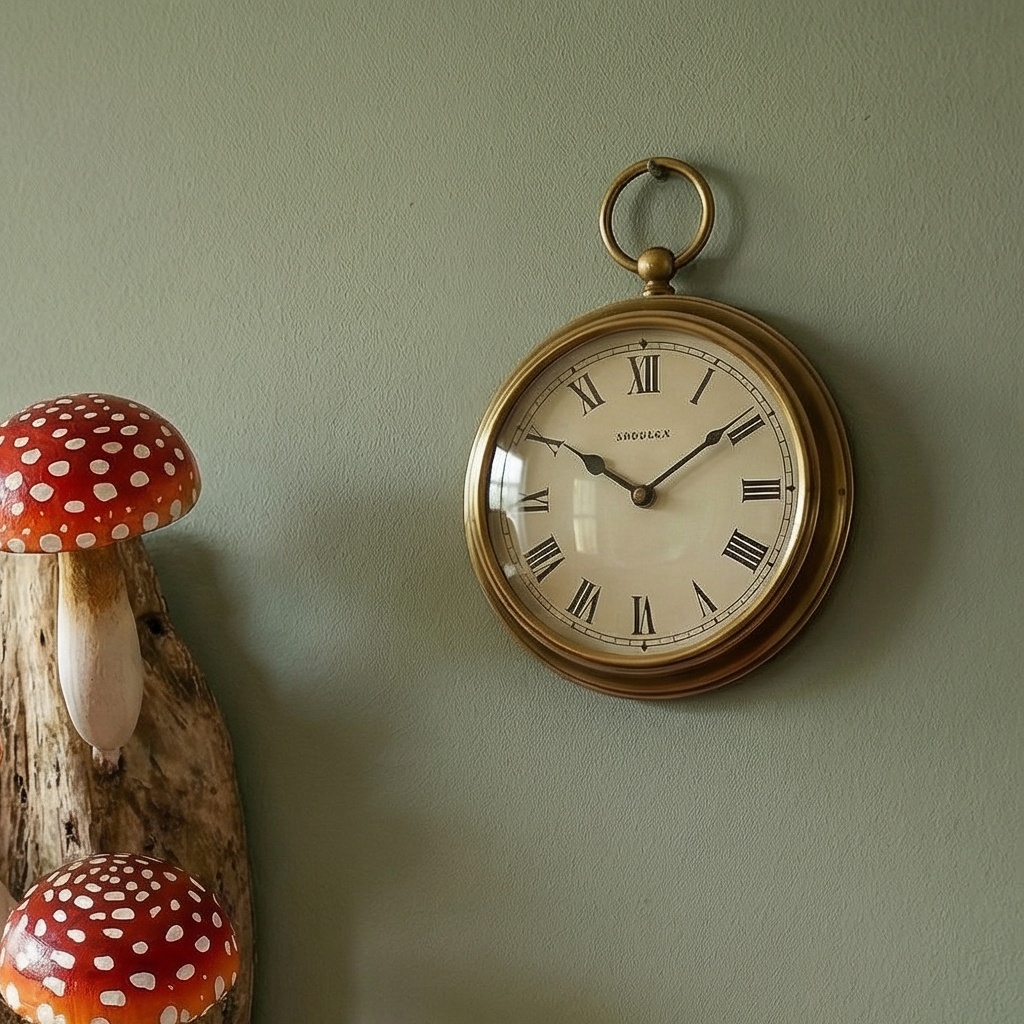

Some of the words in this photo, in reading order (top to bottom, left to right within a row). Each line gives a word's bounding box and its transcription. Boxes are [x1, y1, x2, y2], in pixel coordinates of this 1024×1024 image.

[627, 355, 661, 395] XII
[566, 372, 607, 417] XI
[525, 425, 566, 458] X
[727, 413, 766, 446] II
[741, 478, 781, 503] III
